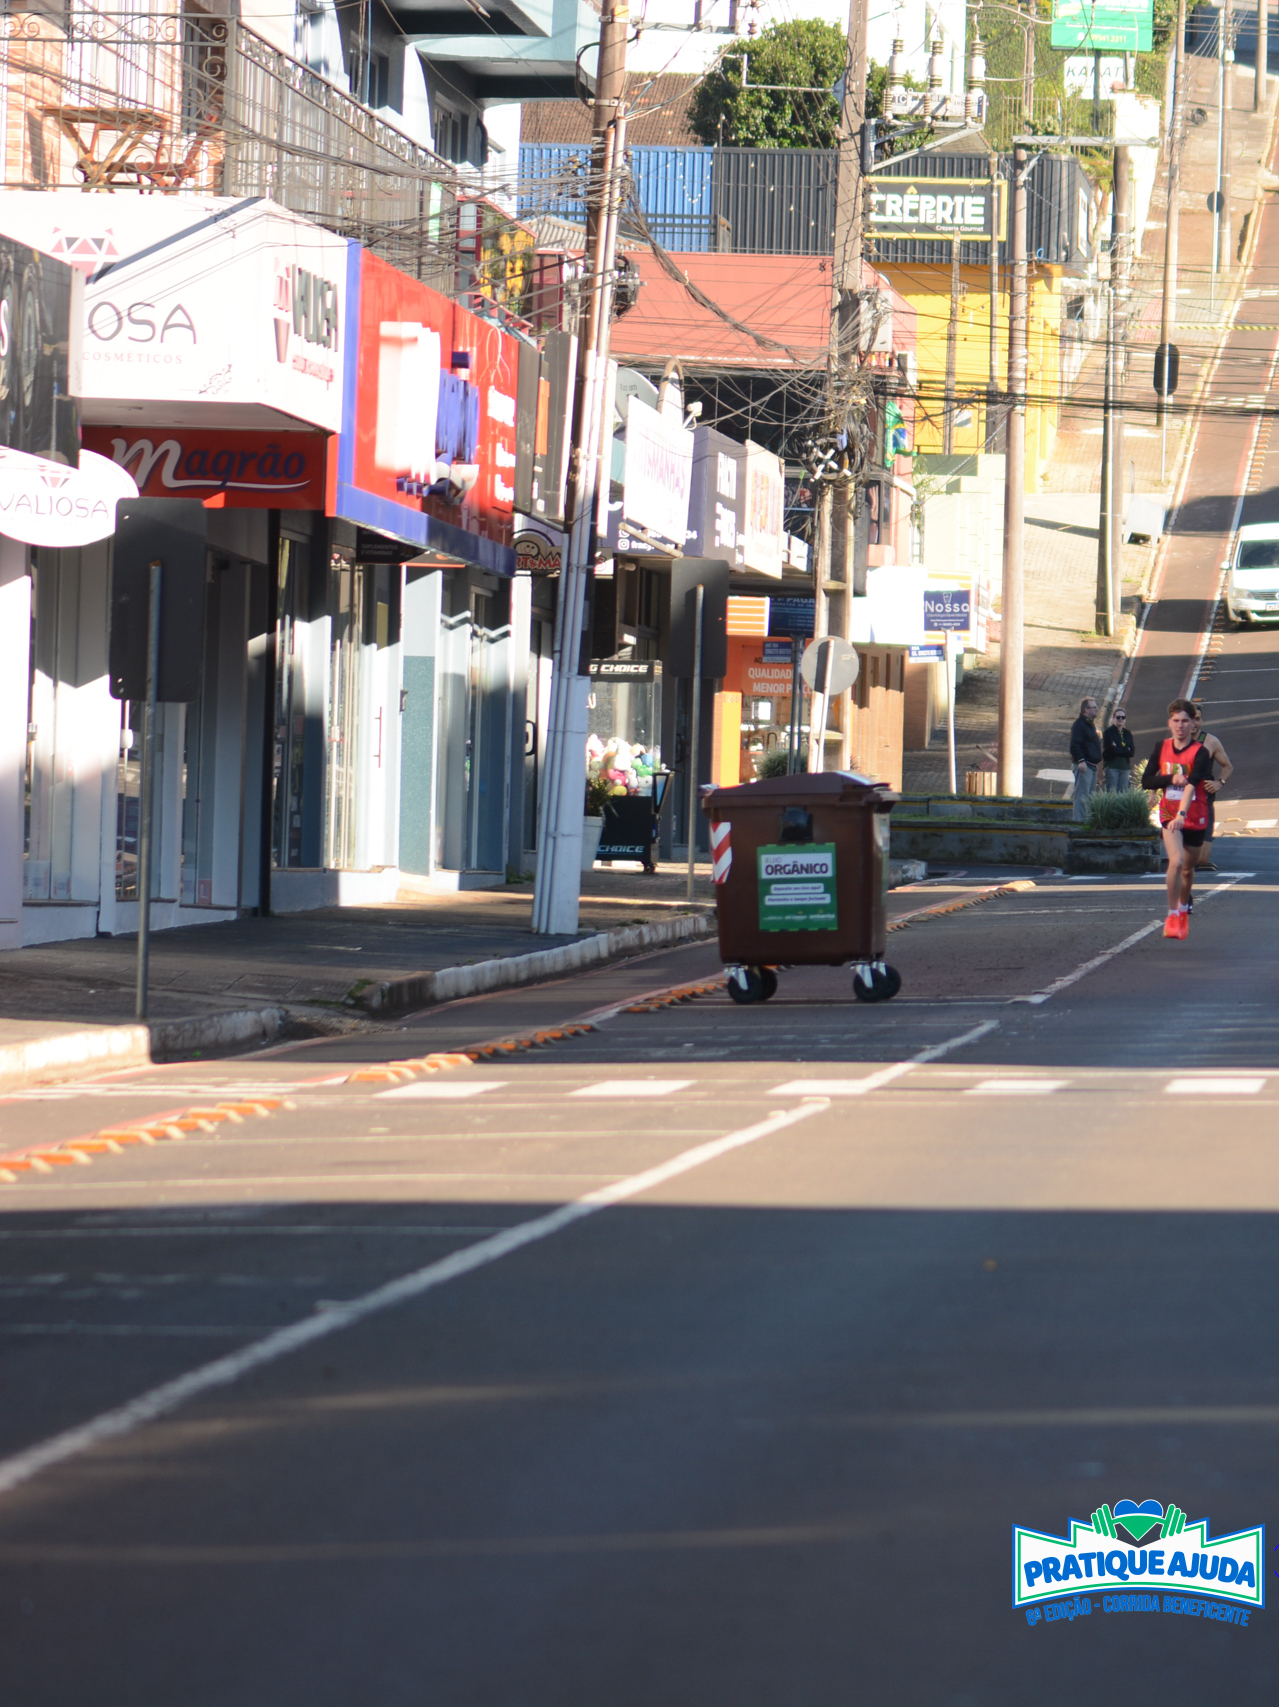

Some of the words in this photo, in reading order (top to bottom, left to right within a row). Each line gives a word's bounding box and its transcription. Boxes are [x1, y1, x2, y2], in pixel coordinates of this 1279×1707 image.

[88, 301, 196, 344] OSA
[82, 351, 183, 364] COSMÉTICOS
[111, 438, 307, 490] Magrão
[0, 493, 109, 520] VALIOSA
[924, 600, 970, 613] Nossa
[600, 664, 649, 673] CHOICE
[753, 682, 785, 694] MENOR
[765, 861, 829, 876] ORGÂNICO
